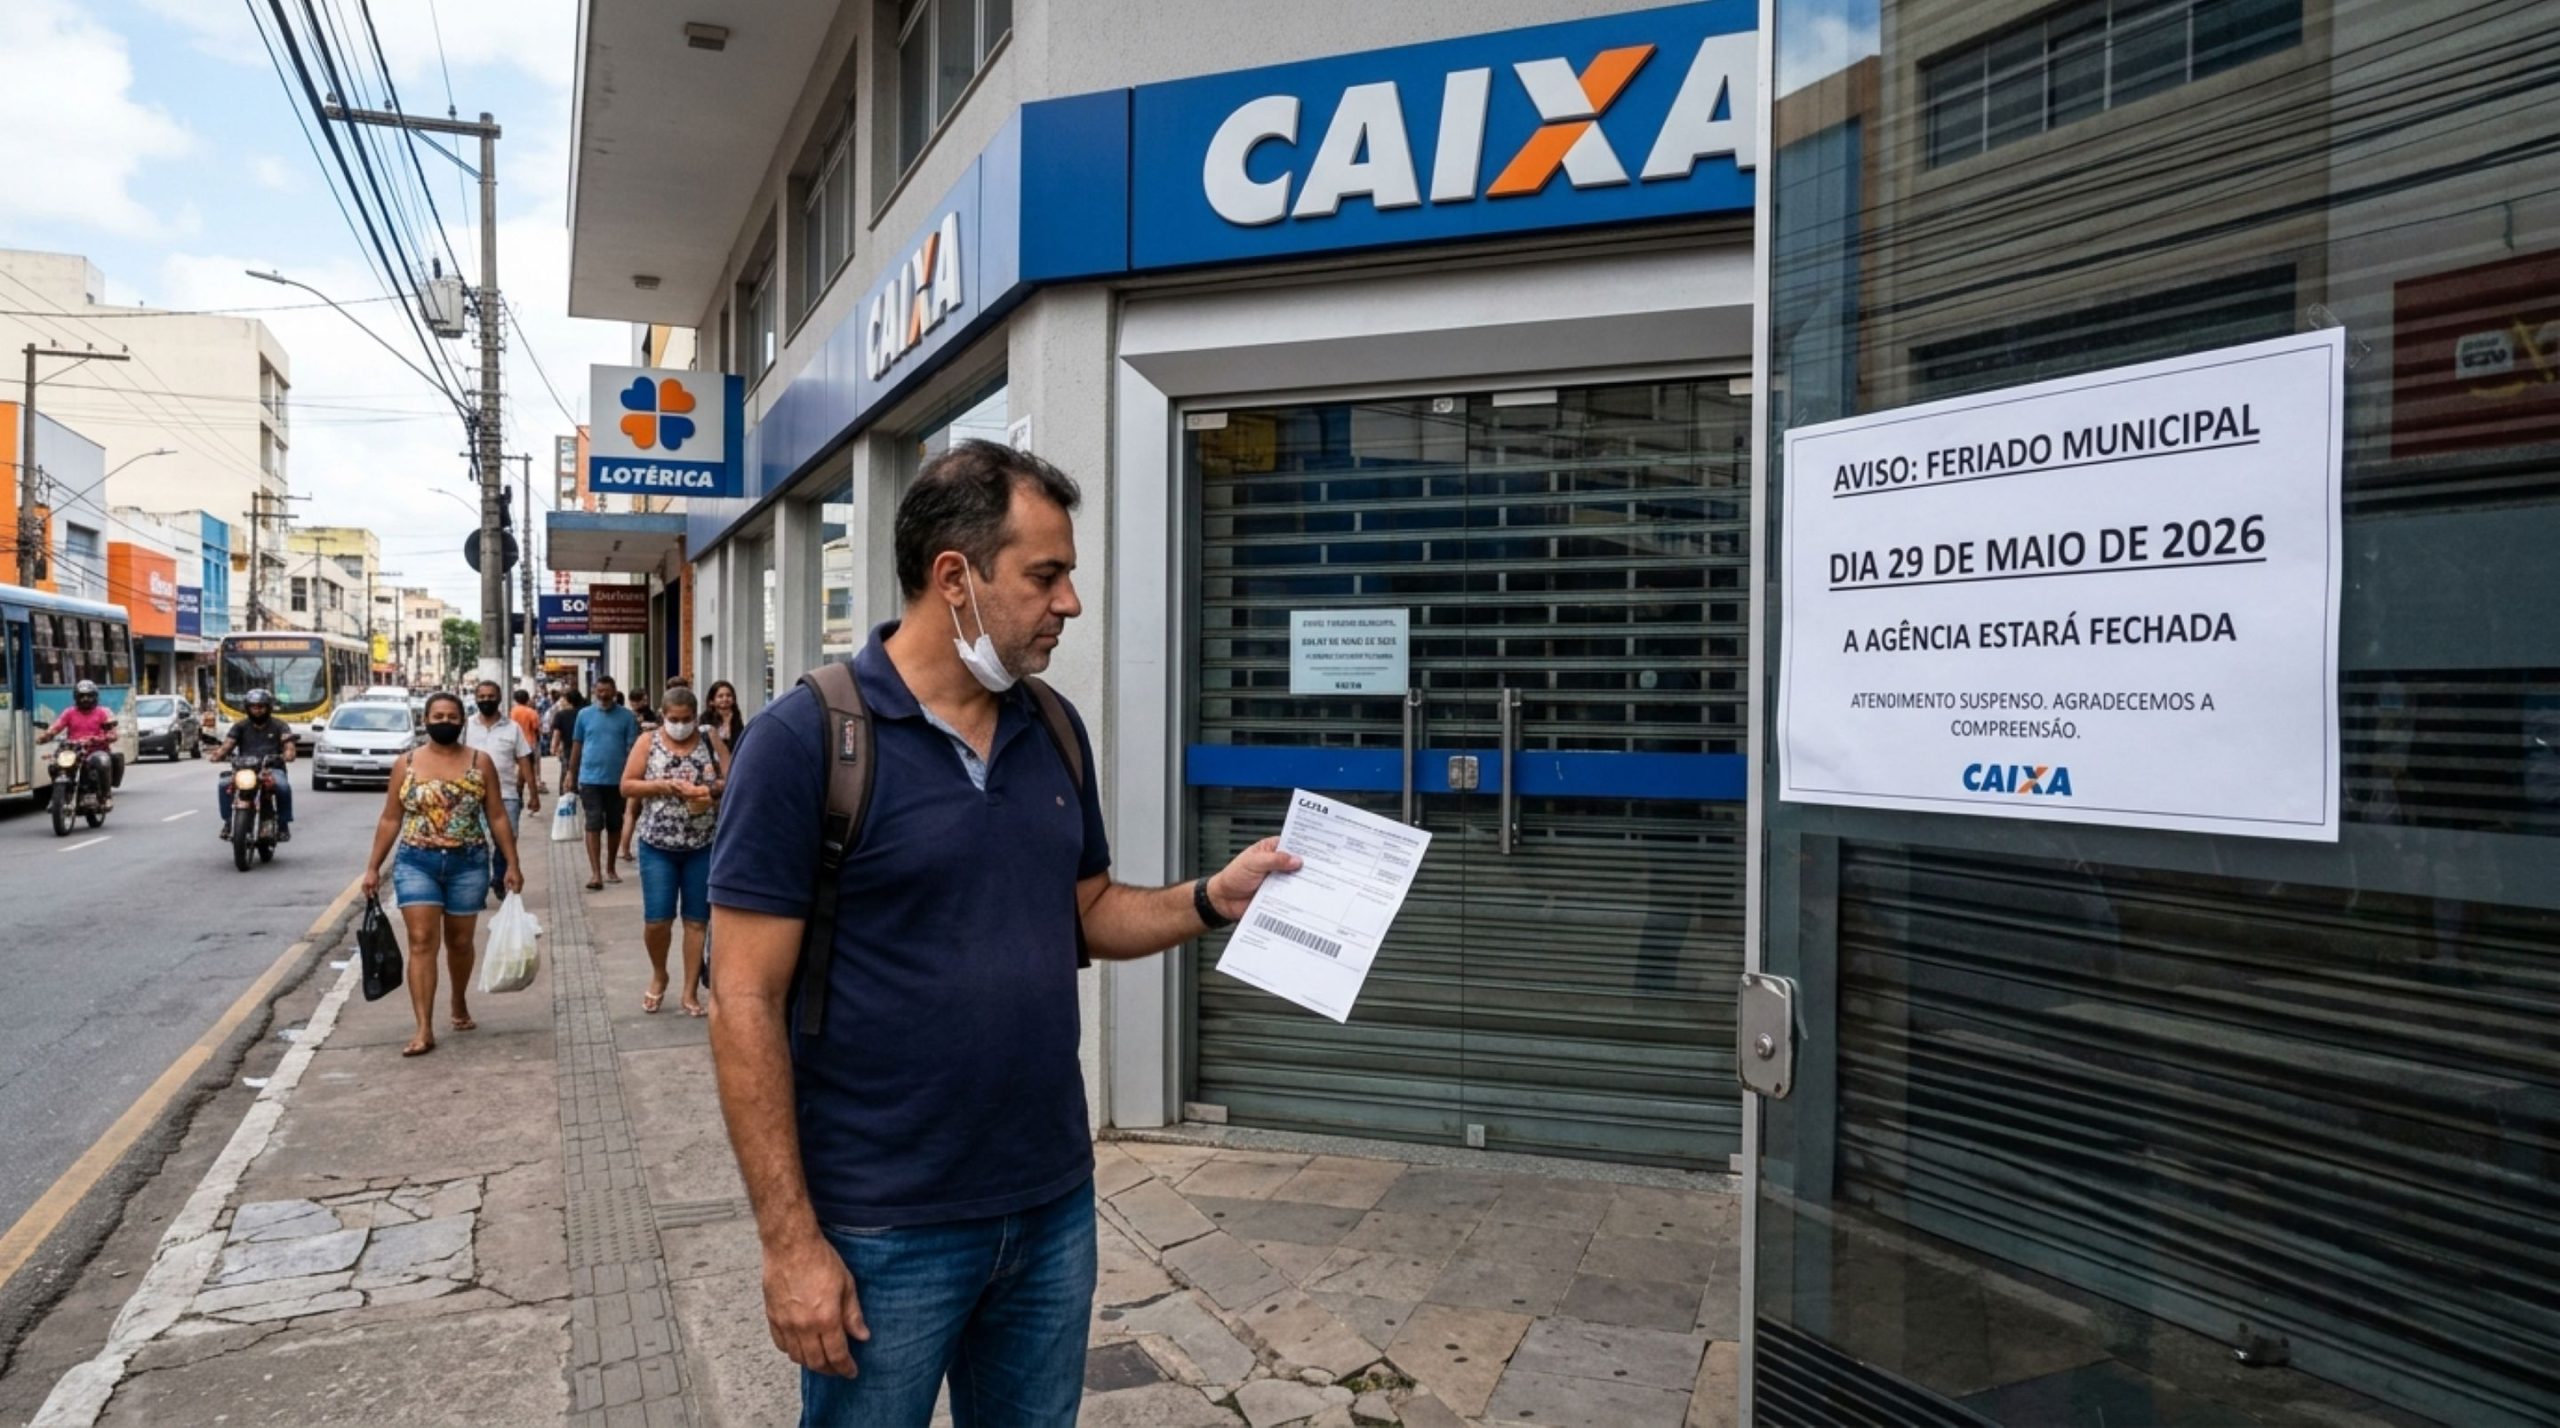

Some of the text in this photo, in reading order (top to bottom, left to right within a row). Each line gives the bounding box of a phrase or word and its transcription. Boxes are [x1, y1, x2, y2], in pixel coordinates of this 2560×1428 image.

[1203, 30, 1758, 226] CAIXA
[866, 212, 962, 381] CAIXA
[1833, 403, 2261, 492] AVISO: FERIADO MUNICIPAL
[600, 465, 714, 488] LOTÉRICA
[1830, 514, 2266, 584] DIA 29 DE MAIO DE 2026
[1843, 610, 2237, 653] A AGÊNCIA ESTARÁ FECHADA
[1850, 692, 2216, 712] ATENDIMENTO SUSPENSO. AGRADECEMOS A
[1962, 763, 2073, 797] CAIXA
